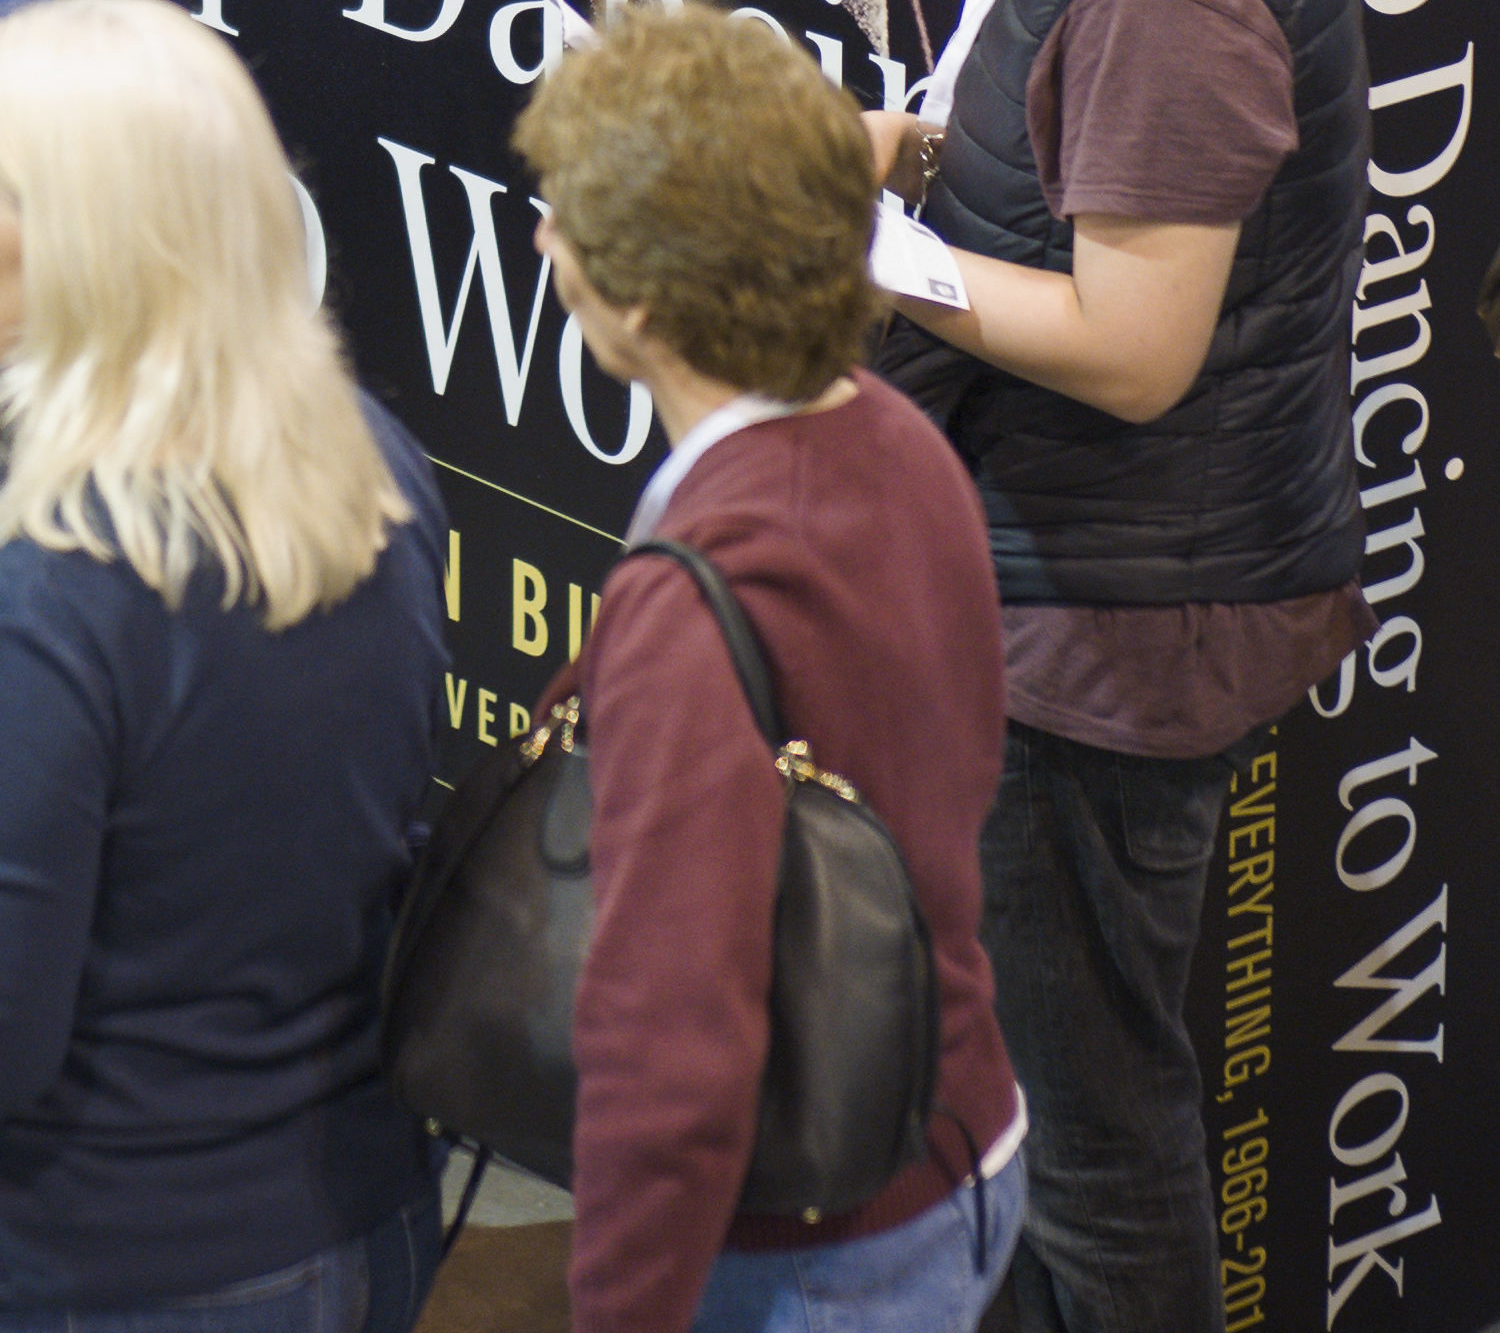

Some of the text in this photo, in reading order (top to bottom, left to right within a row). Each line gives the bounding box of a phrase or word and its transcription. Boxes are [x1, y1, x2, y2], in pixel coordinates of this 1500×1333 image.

[1308, 41, 1475, 719] Dancing
[1212, 751, 1279, 1106] EVERYTHING,
[1335, 736, 1419, 892] to
[1326, 882, 1448, 1333] Work
